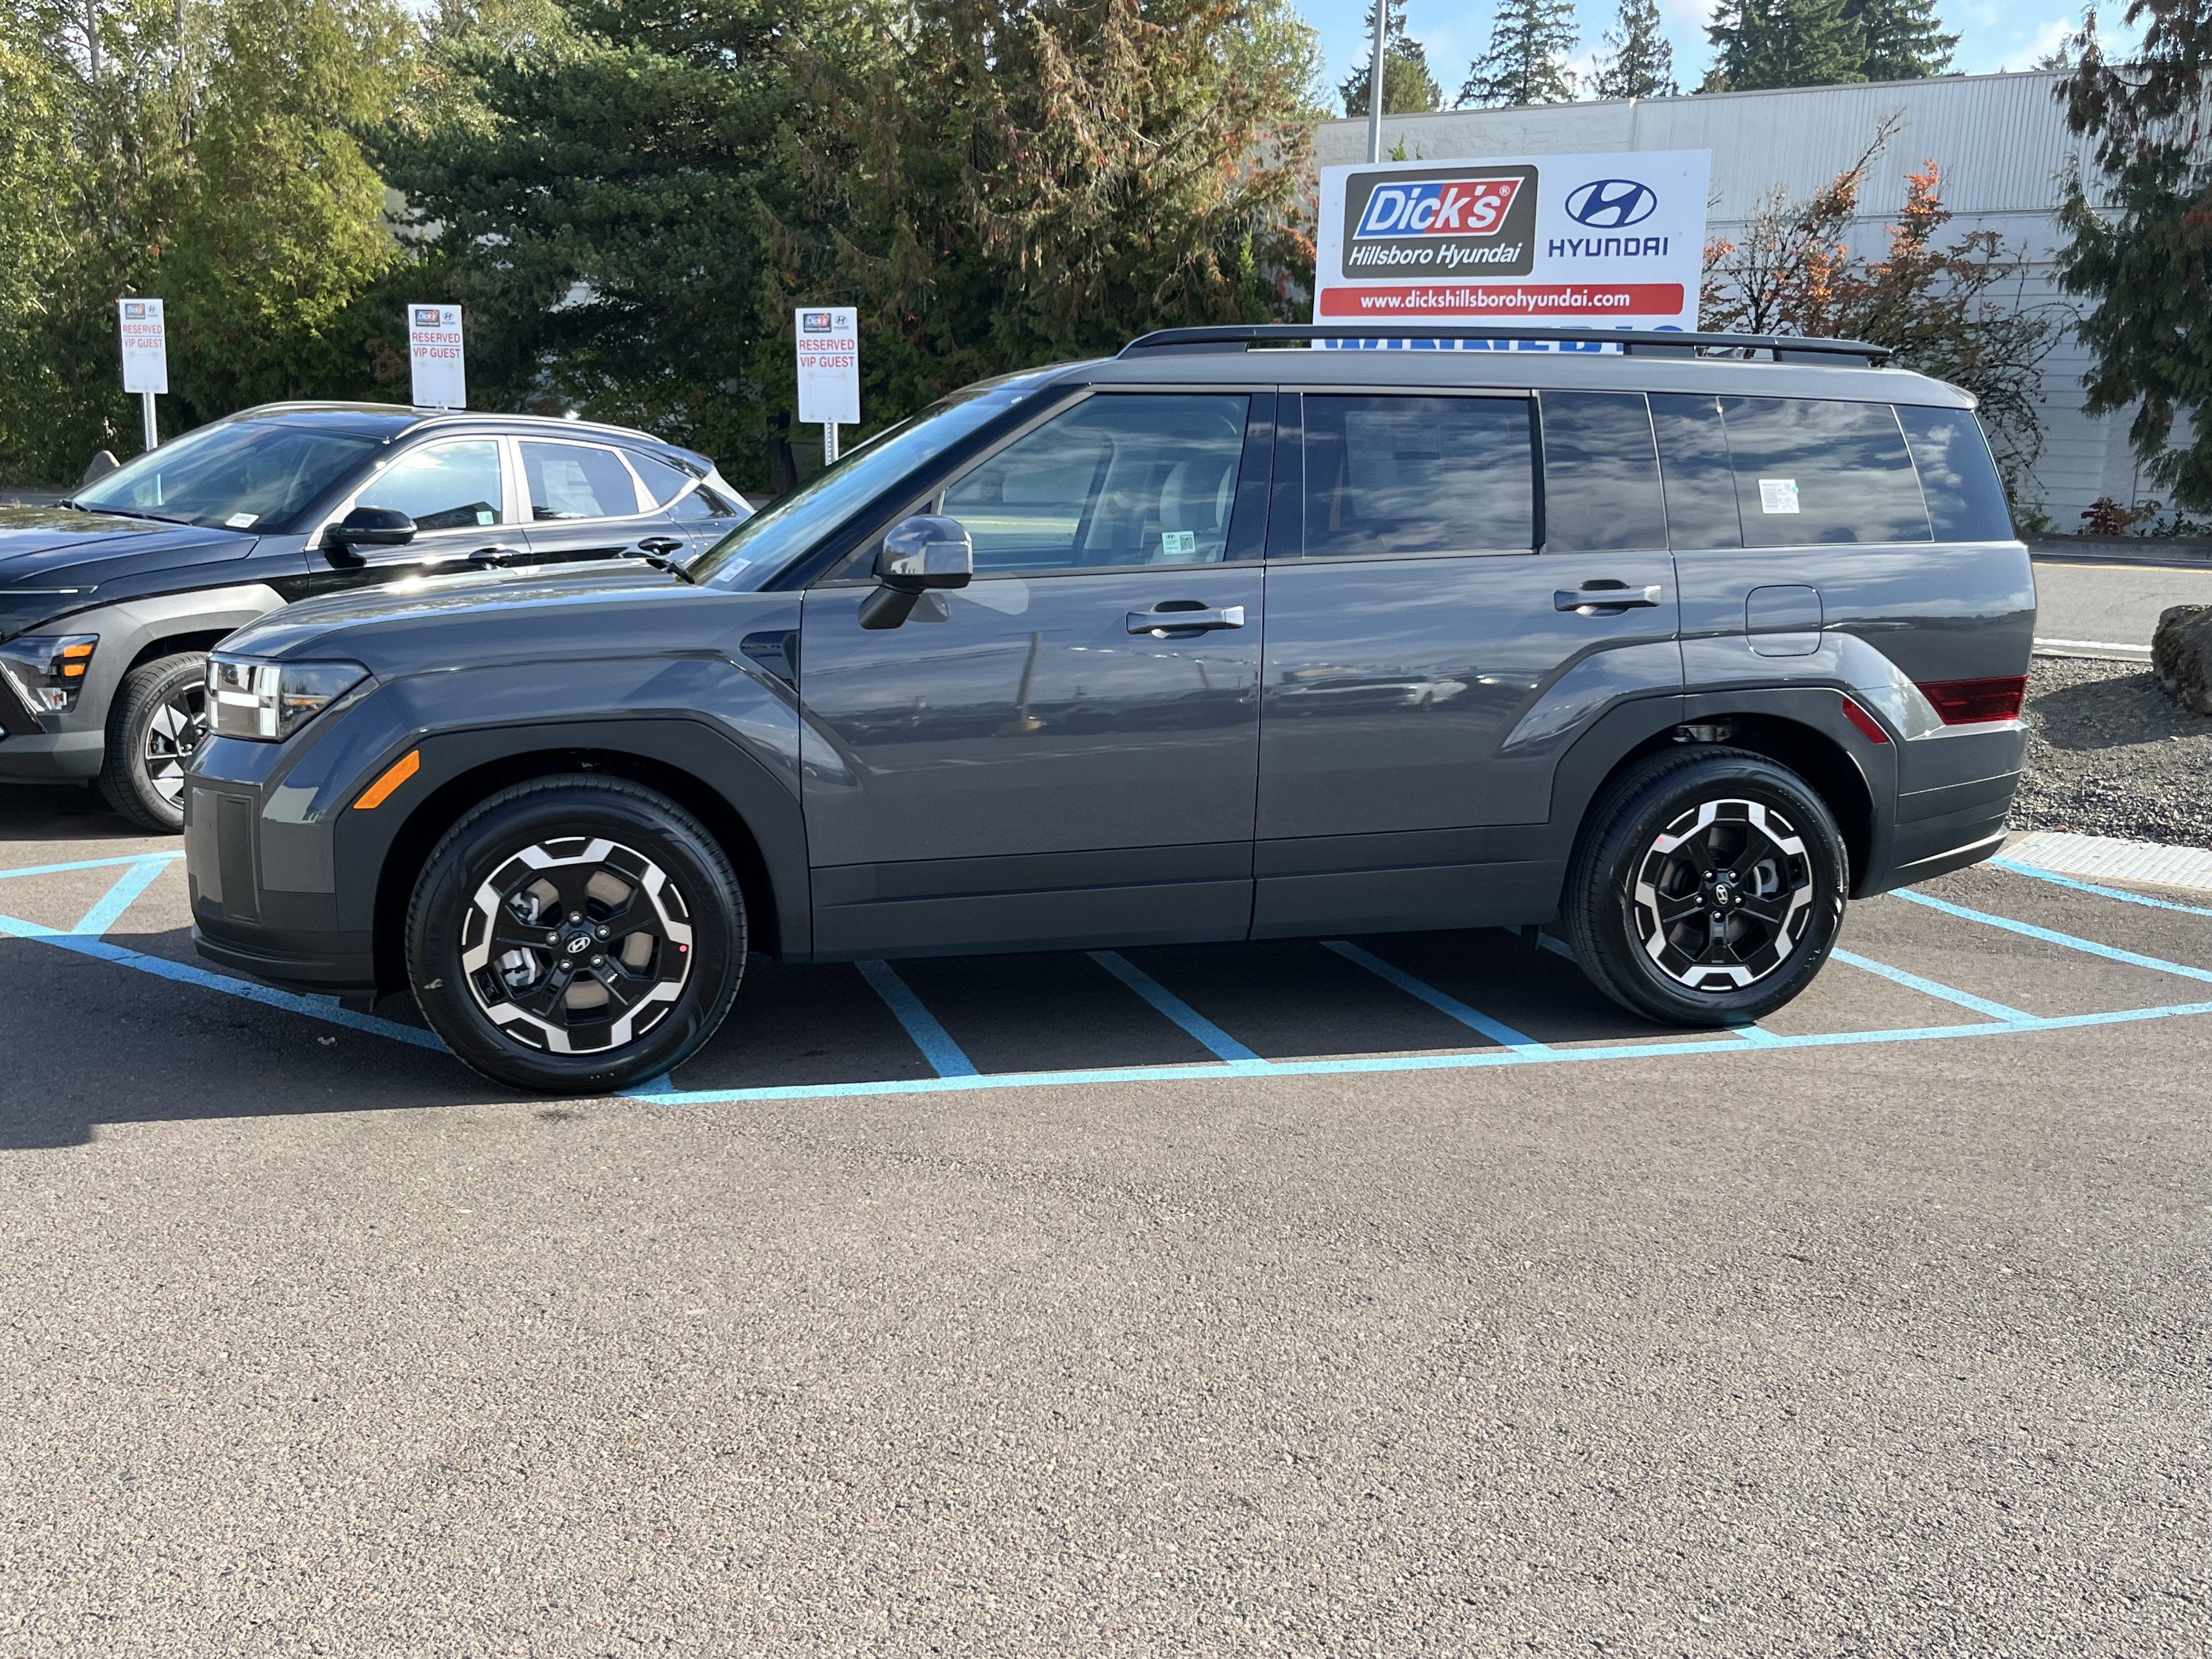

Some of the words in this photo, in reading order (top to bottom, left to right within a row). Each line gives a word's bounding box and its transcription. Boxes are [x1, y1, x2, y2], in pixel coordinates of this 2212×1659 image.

[1548, 237, 1668, 257] HYUNDAI
[1349, 245, 1434, 266] Hillsboro
[1436, 242, 1523, 269] Hyundai
[1361, 289, 1630, 311] www.dickshillsborohyundai.com
[123, 325, 162, 334] RESERVED
[124, 338, 136, 348] VIP
[138, 338, 162, 348] GUEST
[412, 332, 460, 343] RESERVED
[799, 339, 855, 351] RESERVED
[413, 347, 427, 357] VIP
[430, 348, 461, 358] GUEST
[800, 357, 816, 368] VIP
[819, 357, 855, 368] GUEST
